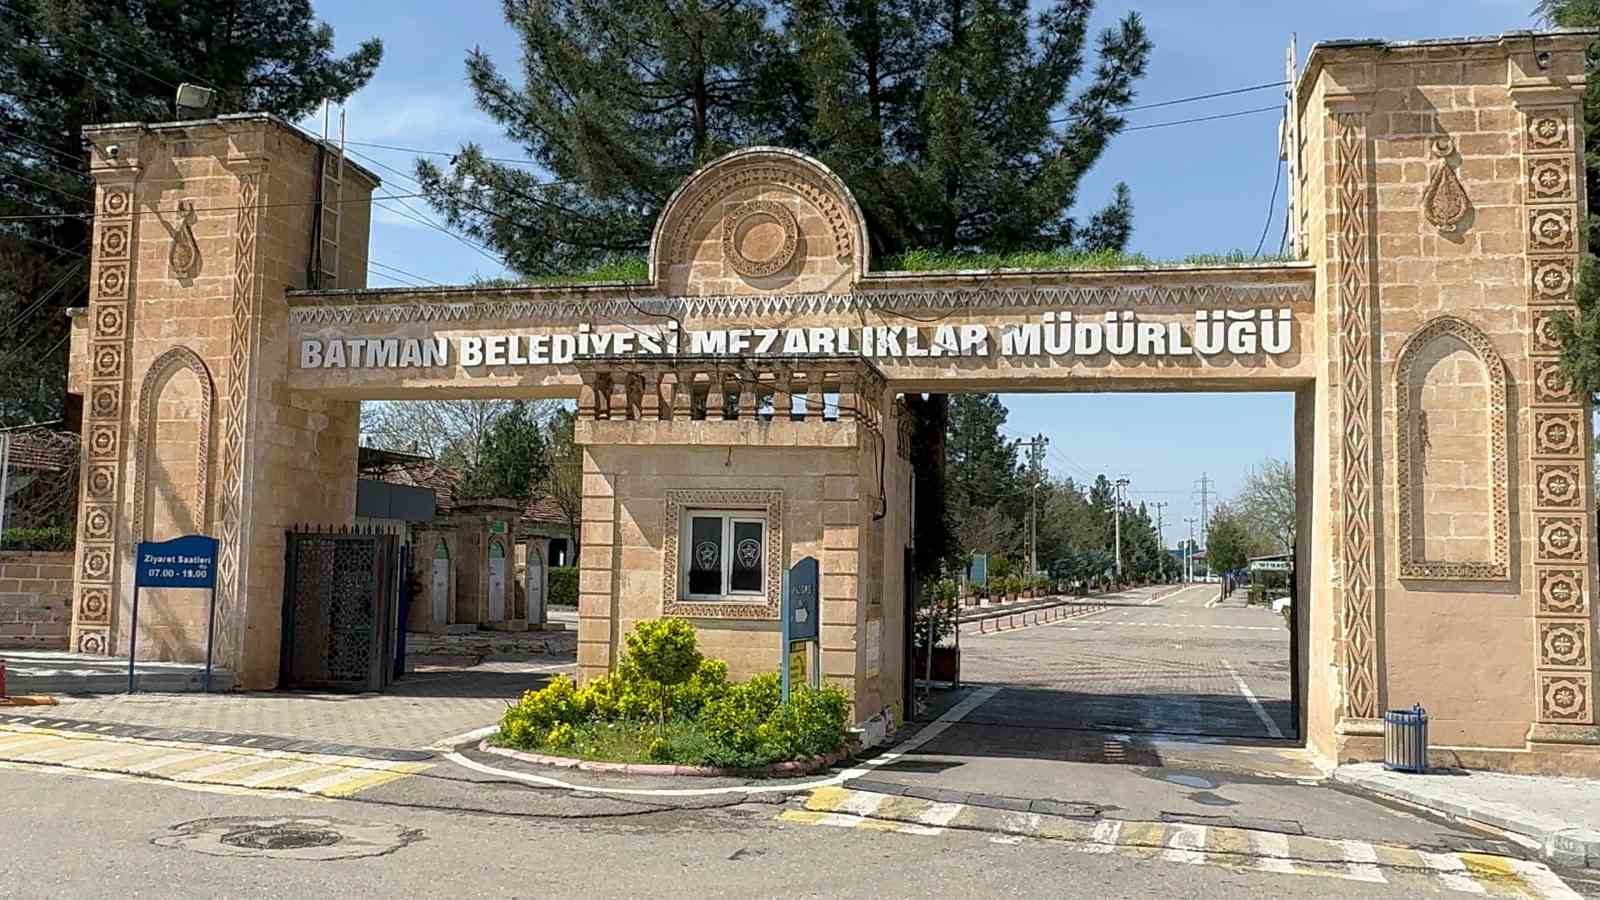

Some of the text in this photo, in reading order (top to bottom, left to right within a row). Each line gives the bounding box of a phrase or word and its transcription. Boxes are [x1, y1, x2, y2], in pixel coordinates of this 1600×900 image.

[301, 308, 1293, 369] BATMAN BELEDİYESİ MEZARLIKLAR MÜDÜRLÜĞÜ
[144, 554, 212, 565] Ziyaret Saatleri
[148, 568, 175, 578] 07.00
